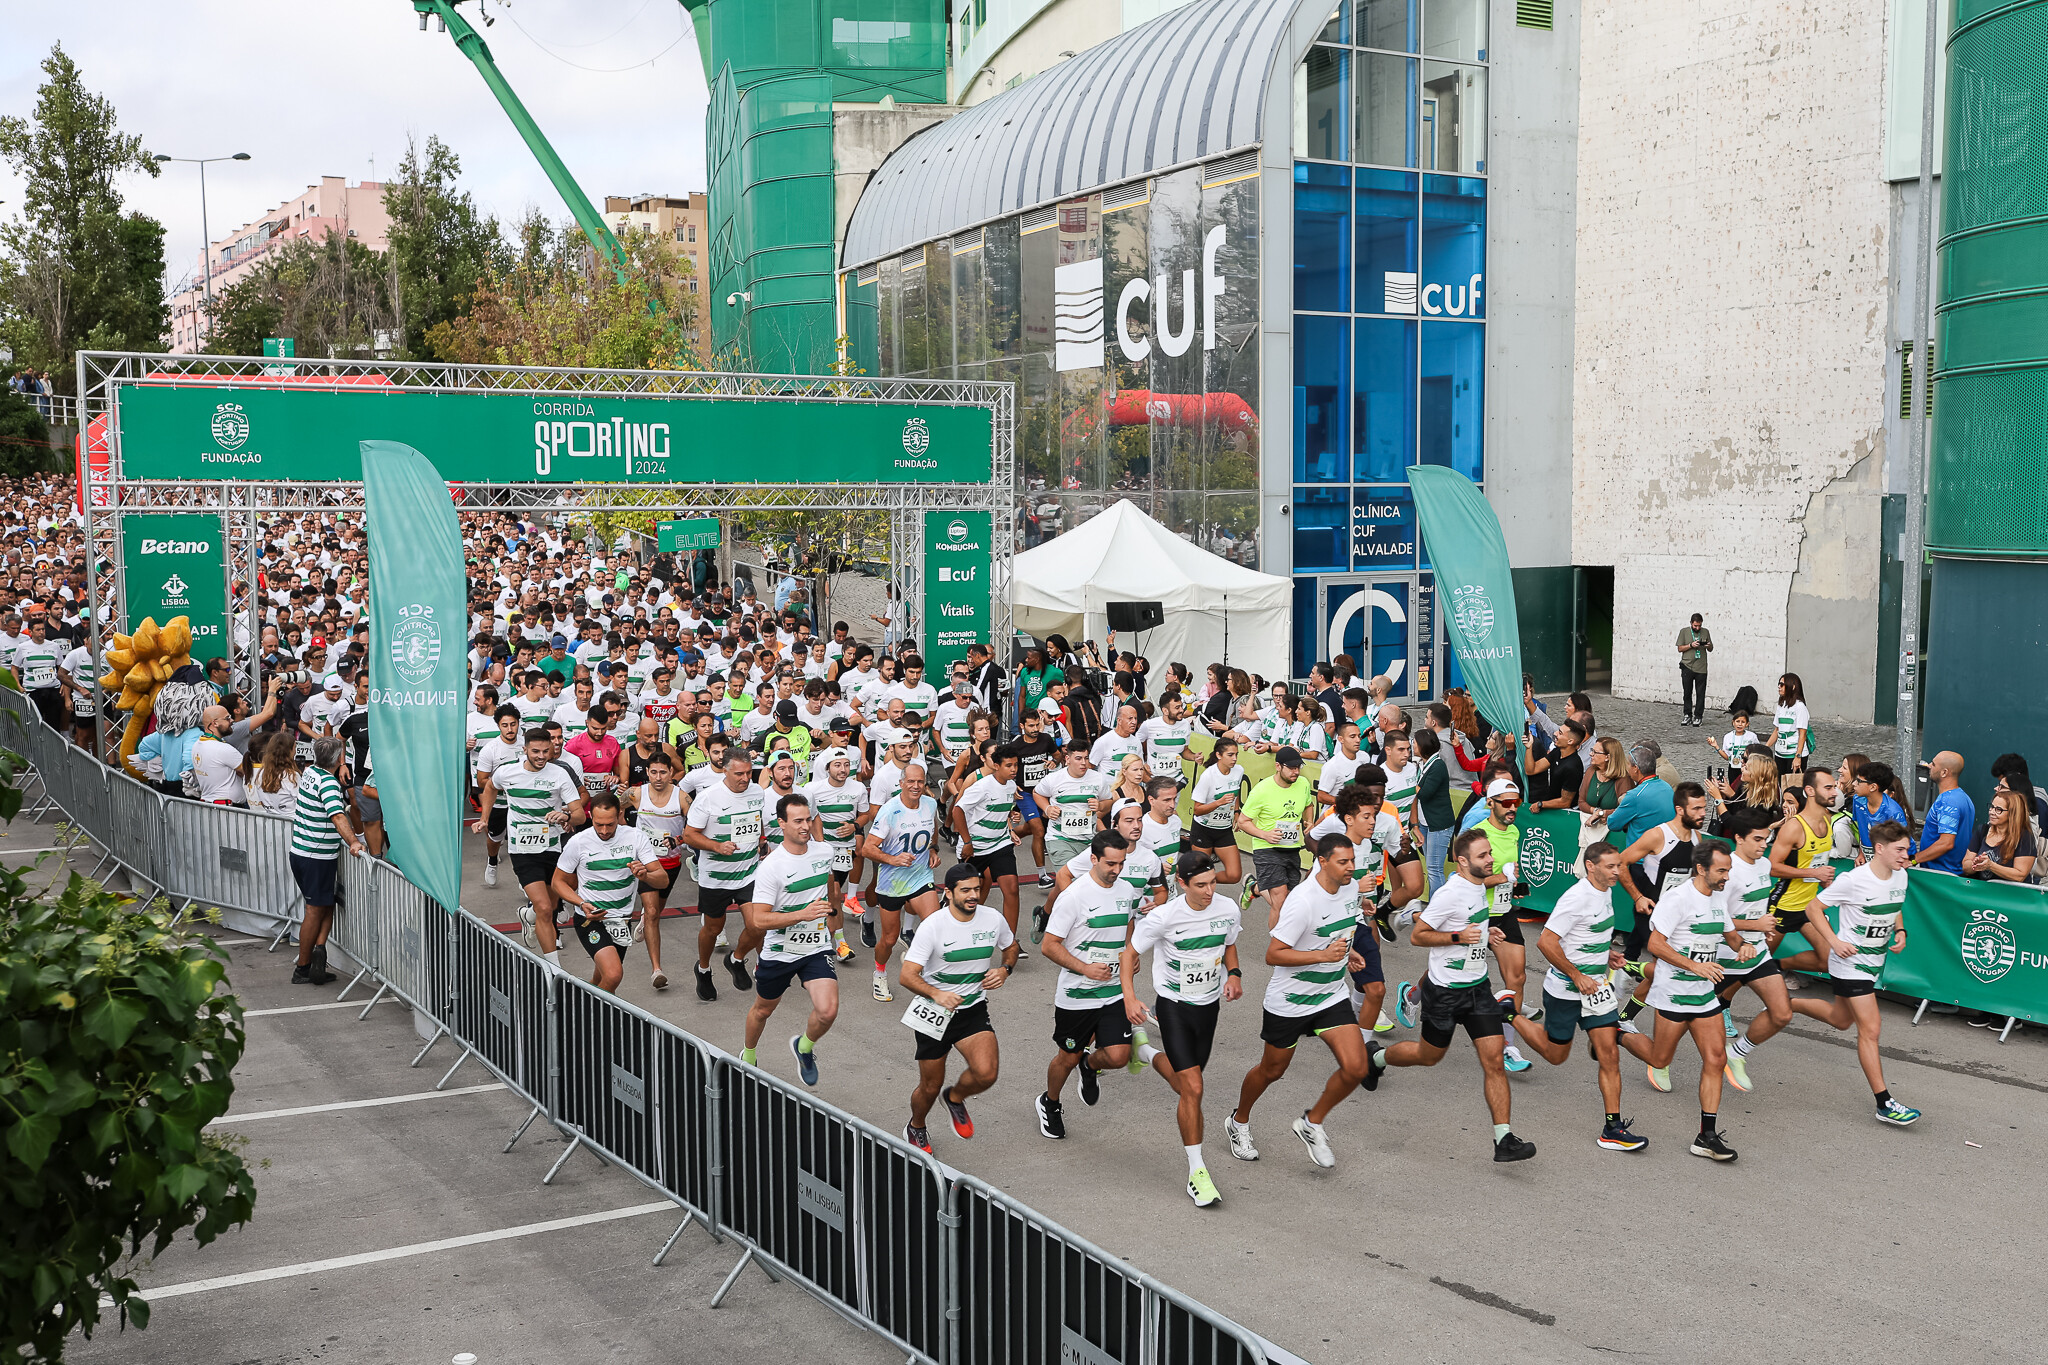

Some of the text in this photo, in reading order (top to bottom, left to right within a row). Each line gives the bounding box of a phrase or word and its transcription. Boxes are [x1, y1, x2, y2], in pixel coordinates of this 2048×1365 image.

[1116, 224, 1227, 362] cuf
[1421, 273, 1482, 316] cuf
[216, 402, 243, 413] SCP
[533, 402, 595, 417] CORRIDA
[906, 417, 927, 426] SCP
[534, 416, 671, 476] SPORTING
[201, 451, 263, 466] FUNDAÇÃO
[894, 458, 938, 470] FUNDAÇÃO
[635, 460, 667, 475] 2024
[1353, 503, 1401, 519] CLÍNICA
[1353, 525, 1376, 538] CUF
[141, 539, 210, 554] Betano
[675, 532, 718, 548] ELITE
[935, 542, 980, 551] KOMBUCHA
[1353, 542, 1413, 556] ALVALADE
[952, 566, 977, 582] cuf
[161, 598, 190, 606] LISBOA
[940, 602, 975, 617] Vitalis
[937, 638, 959, 646] Padre
[938, 630, 977, 639] McDonald's
[1158, 761, 1178, 770] 3101
[735, 824, 759, 836] 2332
[1065, 818, 1089, 827] 4688
[520, 835, 546, 845] 4776
[1526, 827, 1551, 839] SCP
[899, 830, 930, 854] 10
[1525, 840, 1552, 855] SPORTING
[1971, 909, 2009, 924] SCP
[790, 932, 821, 943] 4965
[1967, 925, 2010, 944] SPORTING
[1967, 960, 2007, 976] PORTUGAL
[1186, 968, 1217, 984] 3414
[1587, 988, 1612, 1007] 1323
[912, 1004, 945, 1027] 4520
[622, 1080, 643, 1102] LISBOA
[798, 1182, 842, 1218] C M LISBOA
[1061, 1342, 1069, 1358] C
